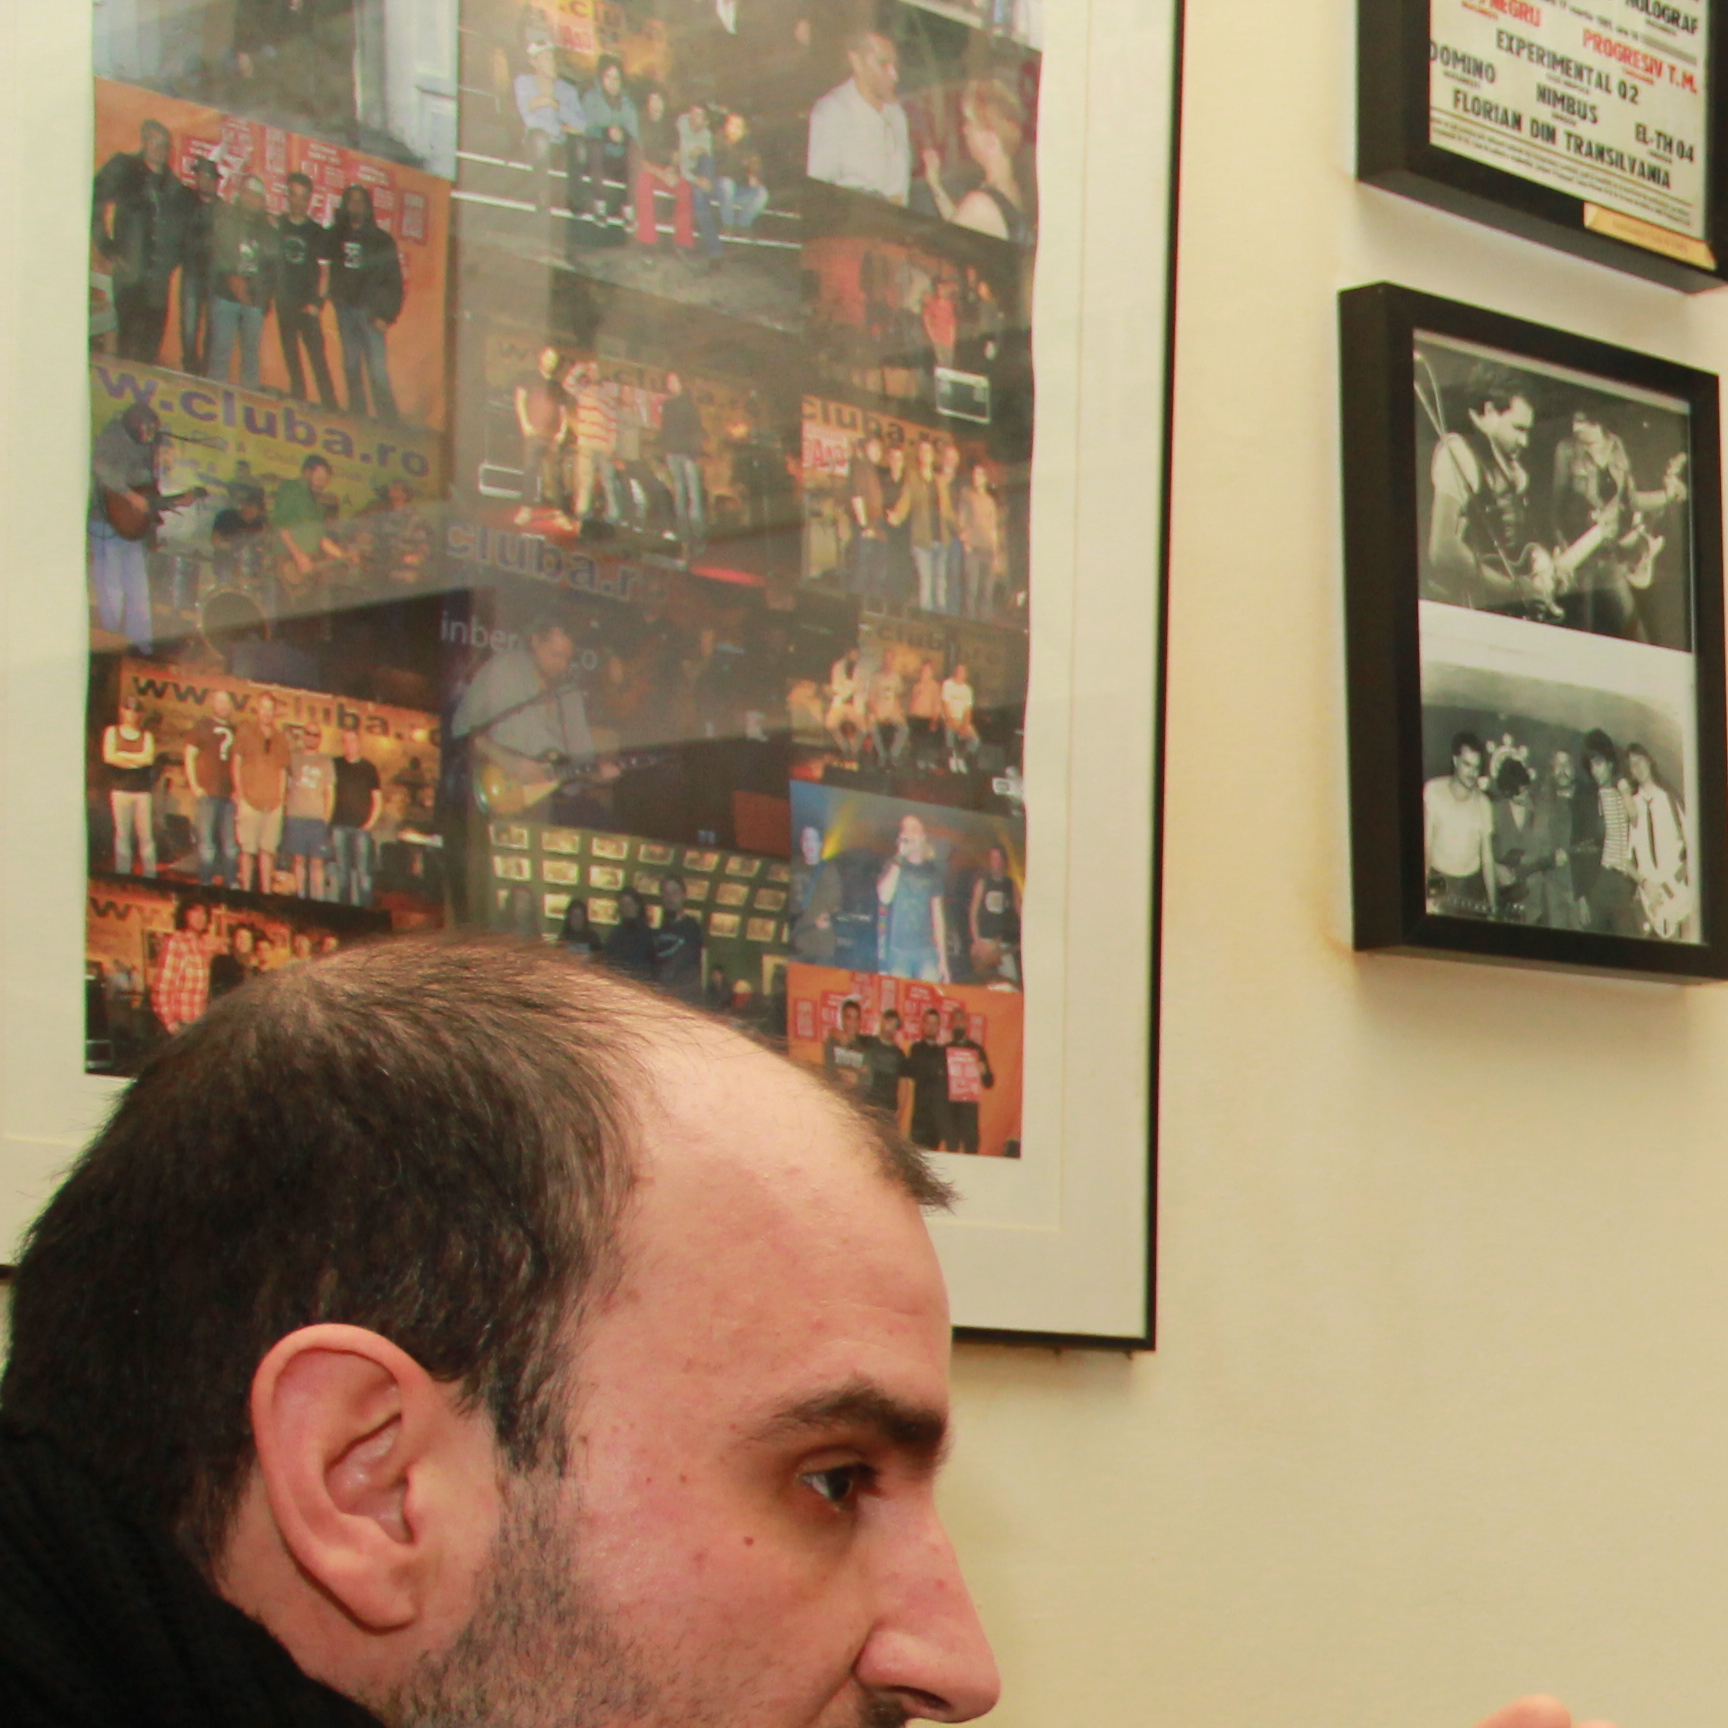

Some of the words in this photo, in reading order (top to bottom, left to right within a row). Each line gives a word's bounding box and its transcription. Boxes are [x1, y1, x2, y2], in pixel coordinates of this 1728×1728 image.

[1430, 40, 1496, 84] DOMINO
[1496, 28, 1613, 95] EXPERIMENTAL
[1536, 82, 1598, 124] NIMBUS
[1453, 87, 1522, 134] FLORIAN
[1530, 116, 1556, 146] DIN
[1564, 129, 1671, 190] TRANSILVANIA
